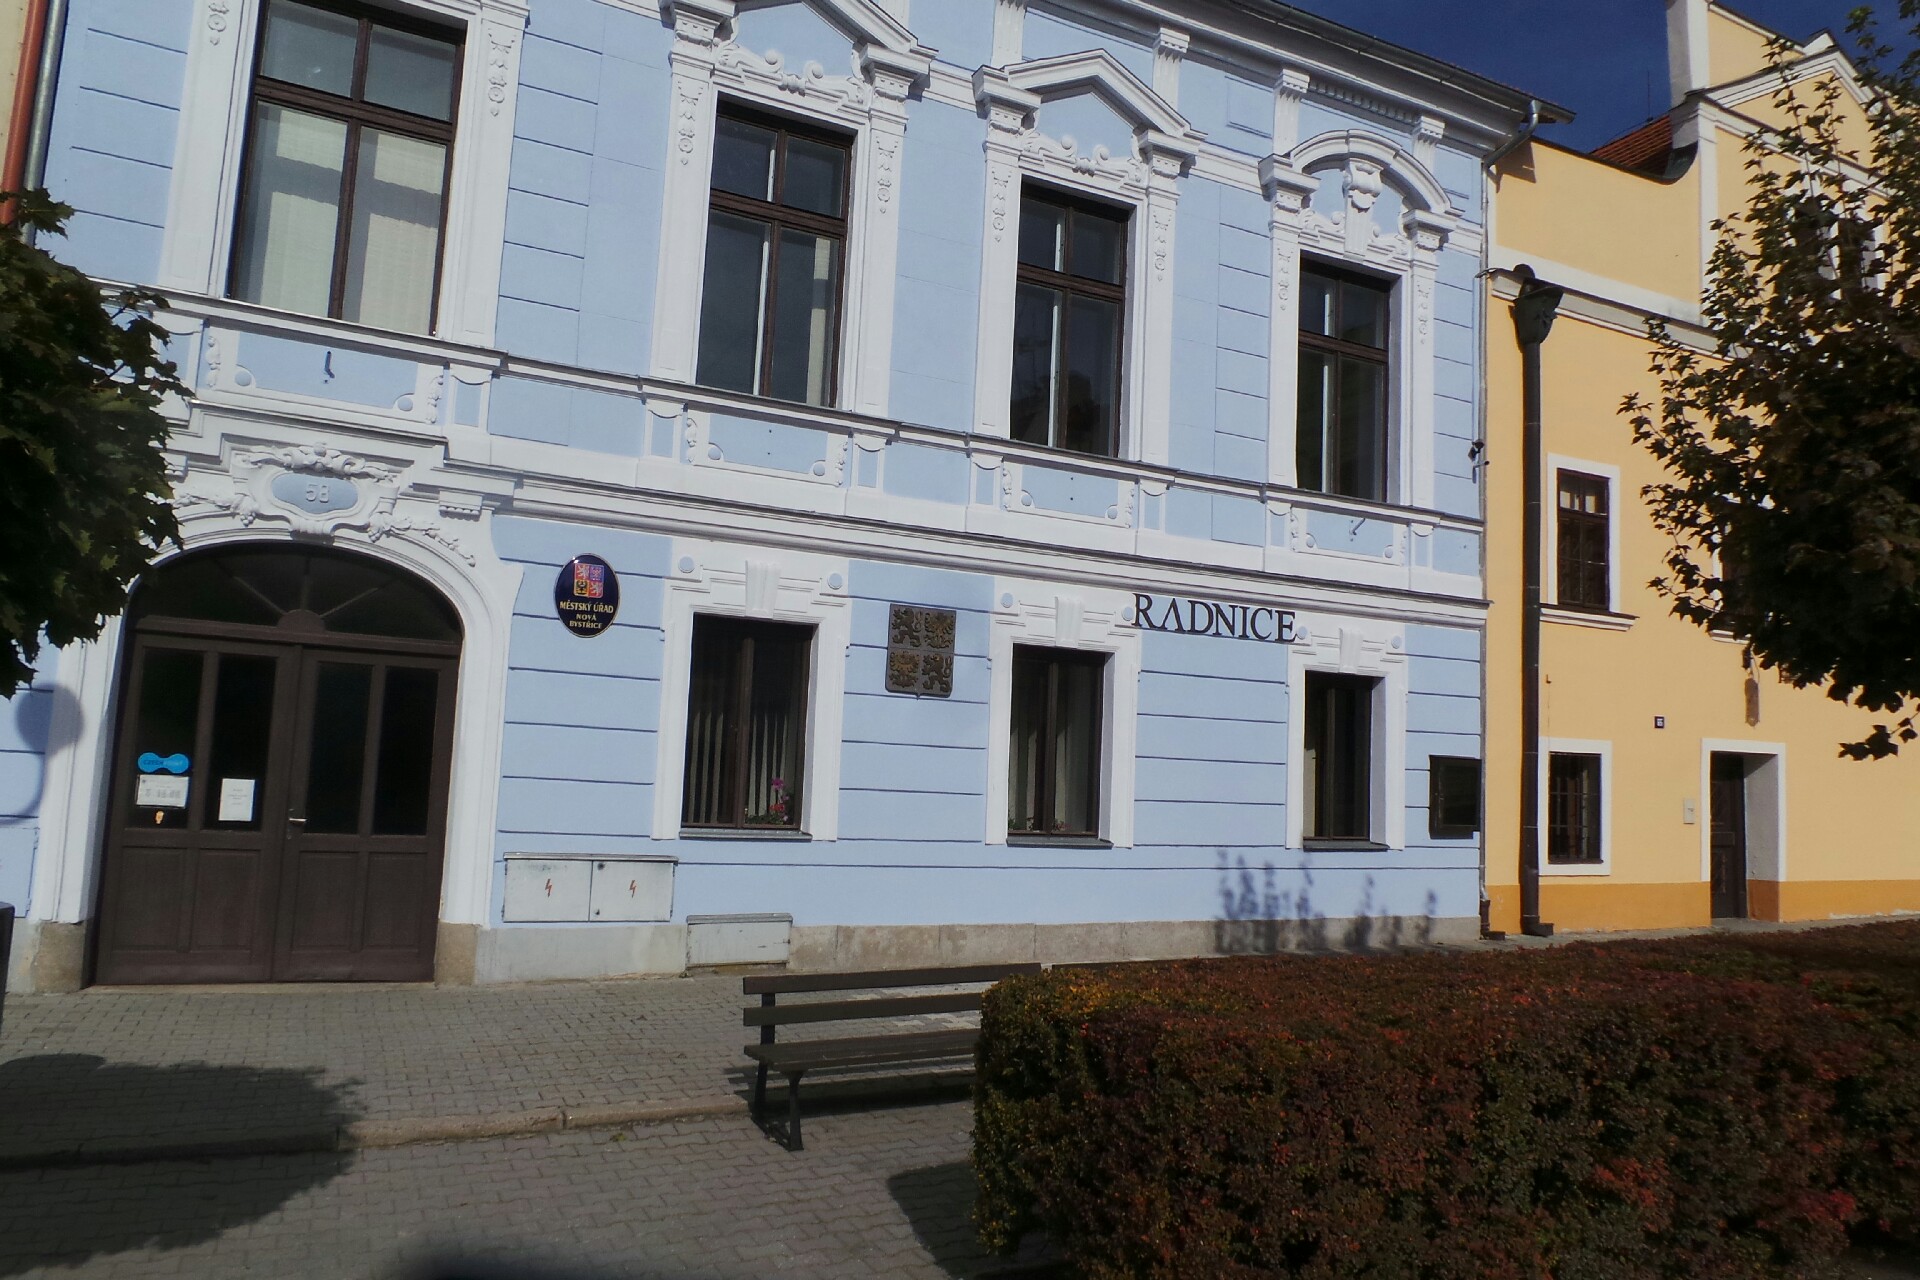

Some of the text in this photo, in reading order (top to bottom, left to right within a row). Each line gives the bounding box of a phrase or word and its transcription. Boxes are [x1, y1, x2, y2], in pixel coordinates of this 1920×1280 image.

[306, 483, 329, 503] 58
[560, 600, 614, 613] MĚSTSKÝ ÚŘAD
[576, 613, 597, 621] NOVÁ
[1131, 593, 1298, 643] RADNICE
[569, 620, 602, 629] BYSTŘICE
